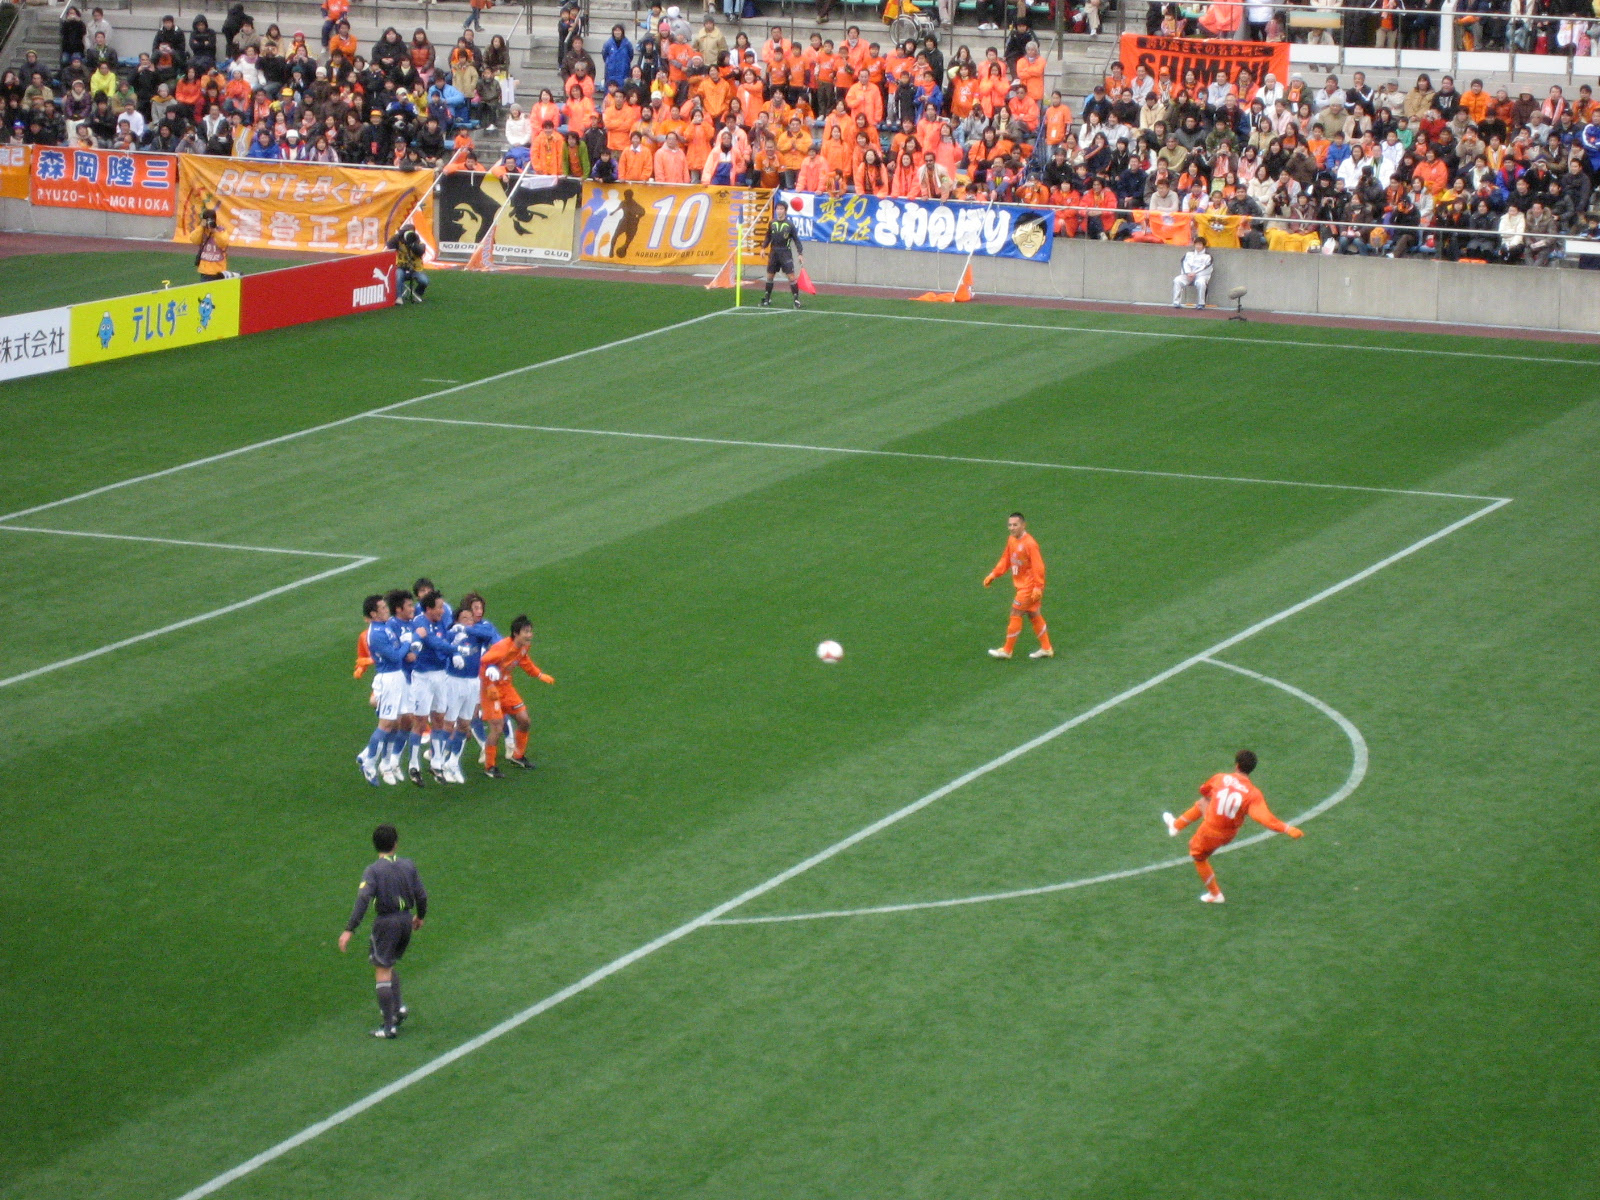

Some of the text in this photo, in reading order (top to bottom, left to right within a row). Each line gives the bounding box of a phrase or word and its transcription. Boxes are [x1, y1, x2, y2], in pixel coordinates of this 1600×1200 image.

[36, 149, 170, 189] 森岡隆三
[647, 192, 711, 250] 10
[874, 199, 1011, 255] さわのぼり
[495, 246, 534, 254] UPPORT
[544, 250, 570, 258] CLUB
[352, 283, 385, 307] PUMA
[0, 326, 65, 363] 株式会社
[1216, 787, 1243, 819] 10
